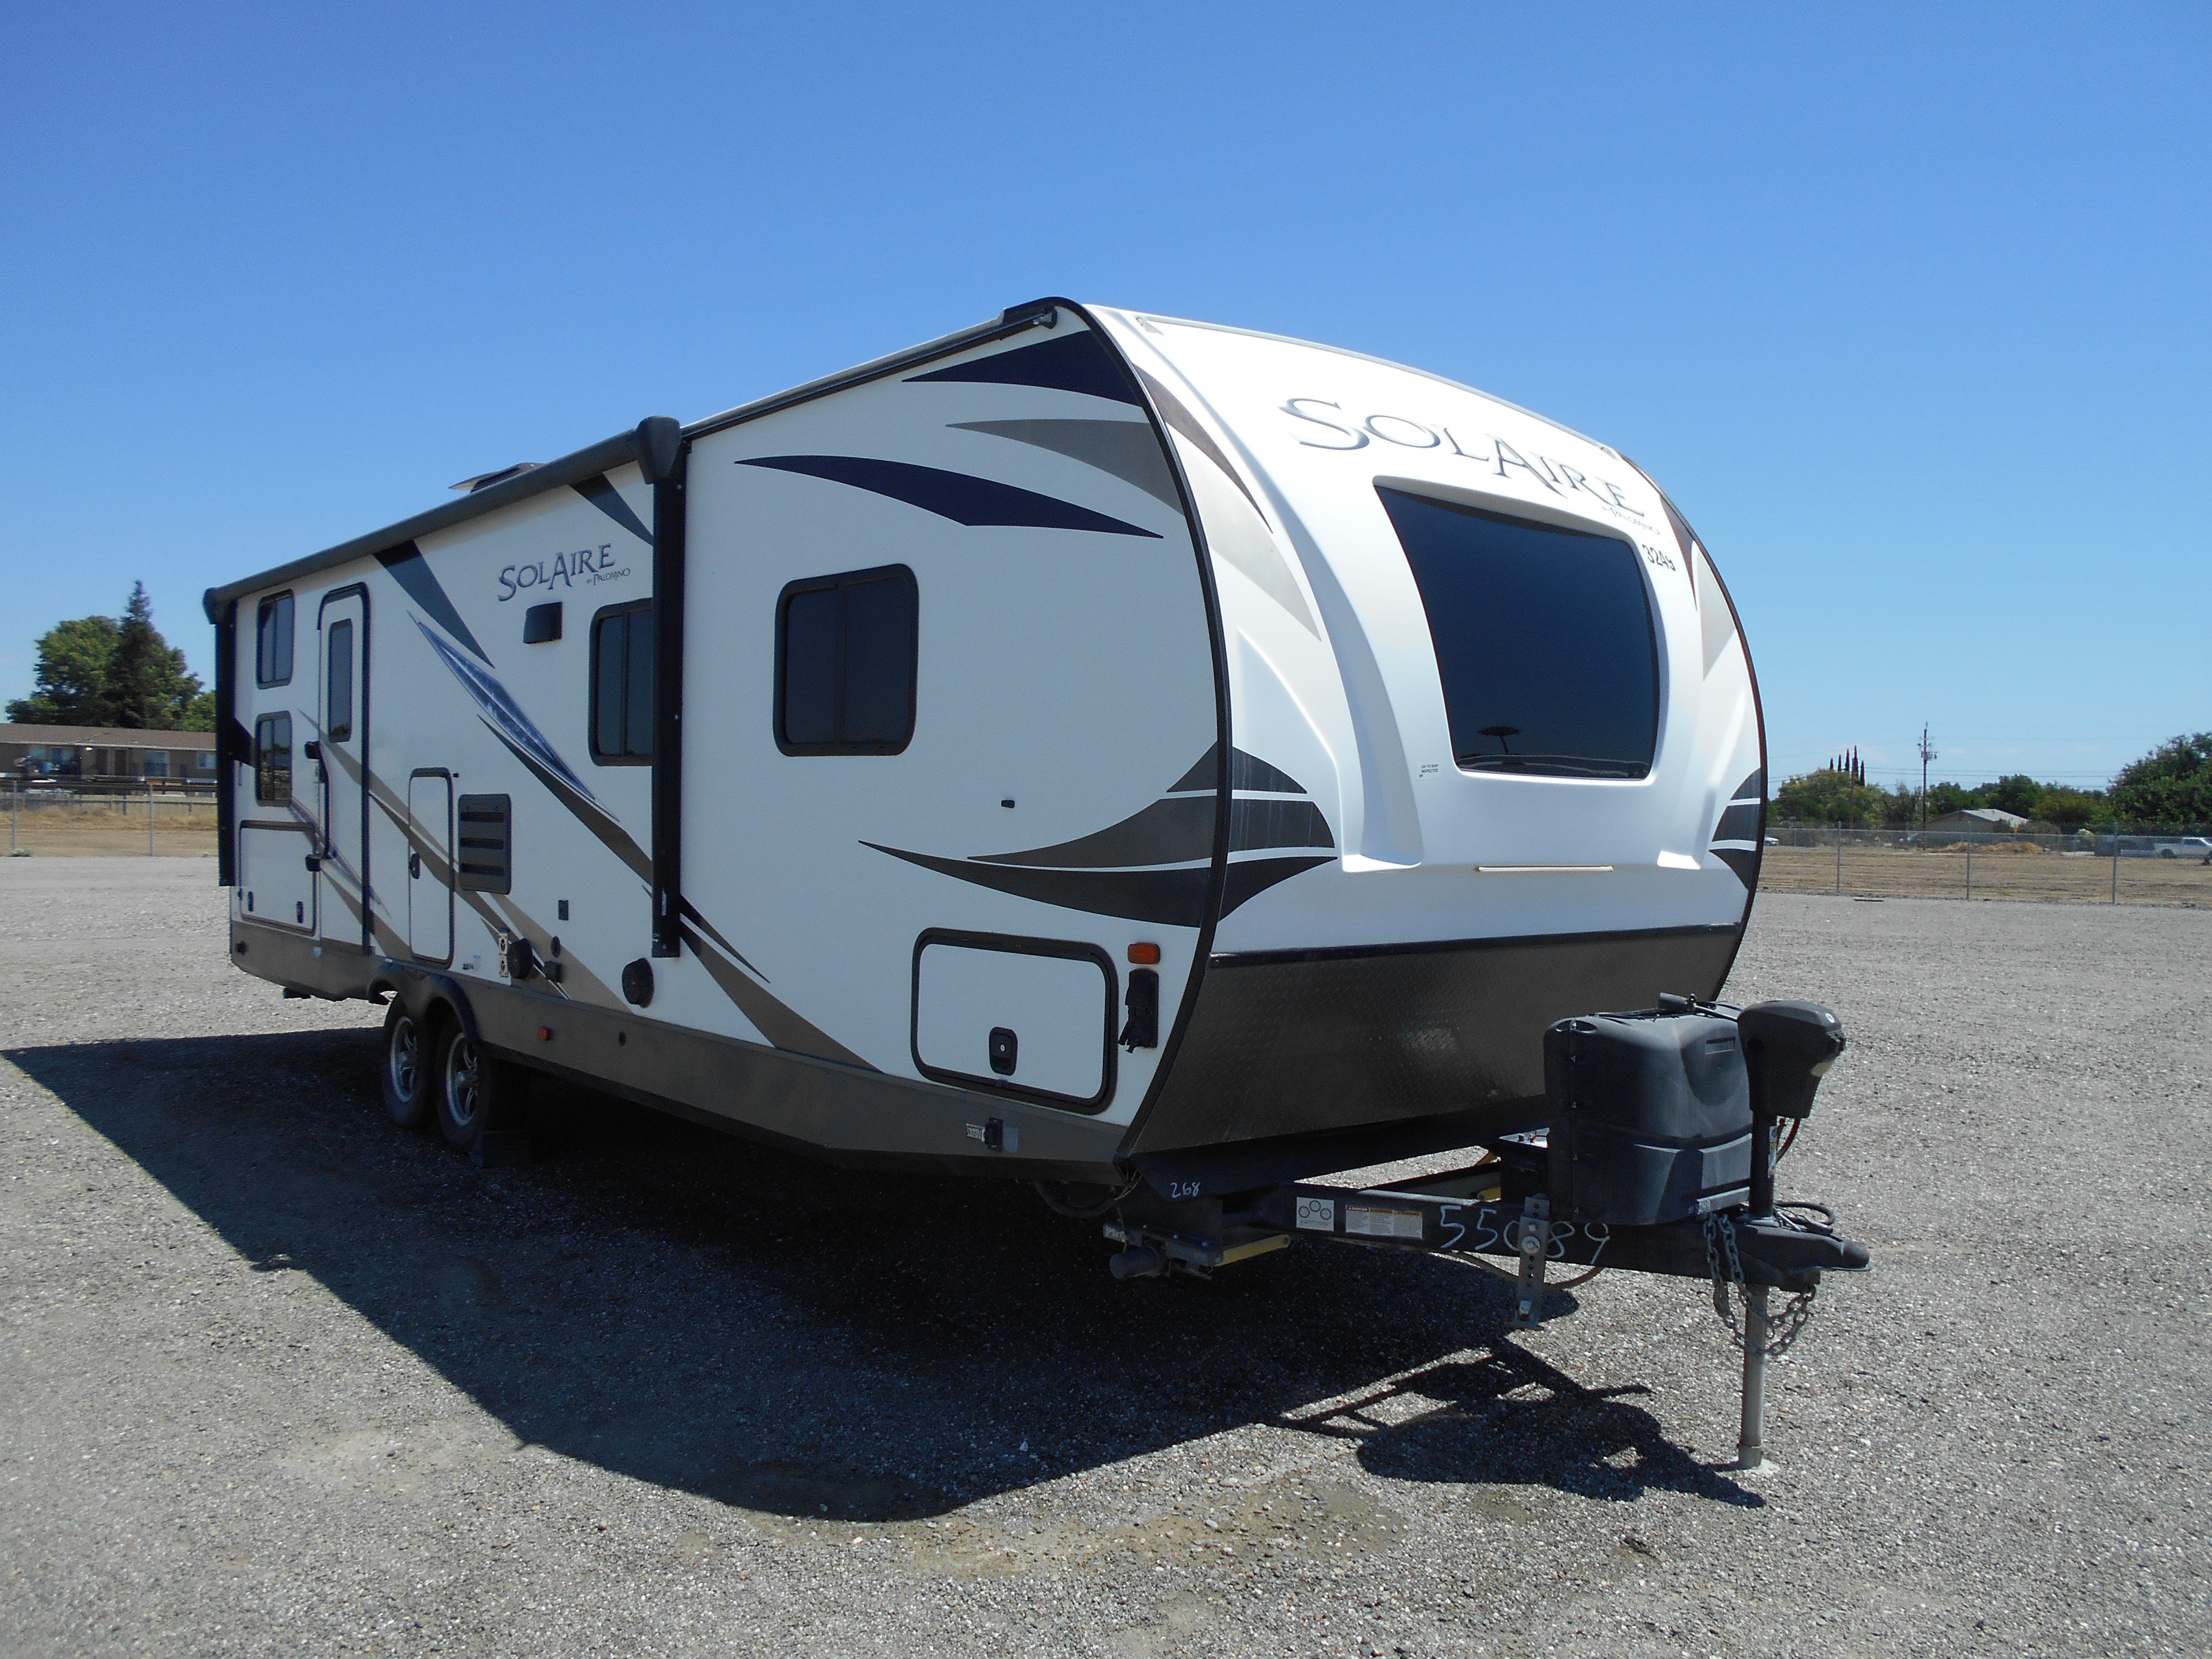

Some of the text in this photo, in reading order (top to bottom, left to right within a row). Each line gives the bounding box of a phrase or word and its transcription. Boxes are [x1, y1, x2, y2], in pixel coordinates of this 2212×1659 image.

[1278, 397, 1645, 517] SOLAIRE
[1642, 544, 1676, 571] 3249
[497, 543, 616, 601] SOLAIRE
[593, 568, 631, 585] PALOMINO
[1170, 1182, 1201, 1198] 268
